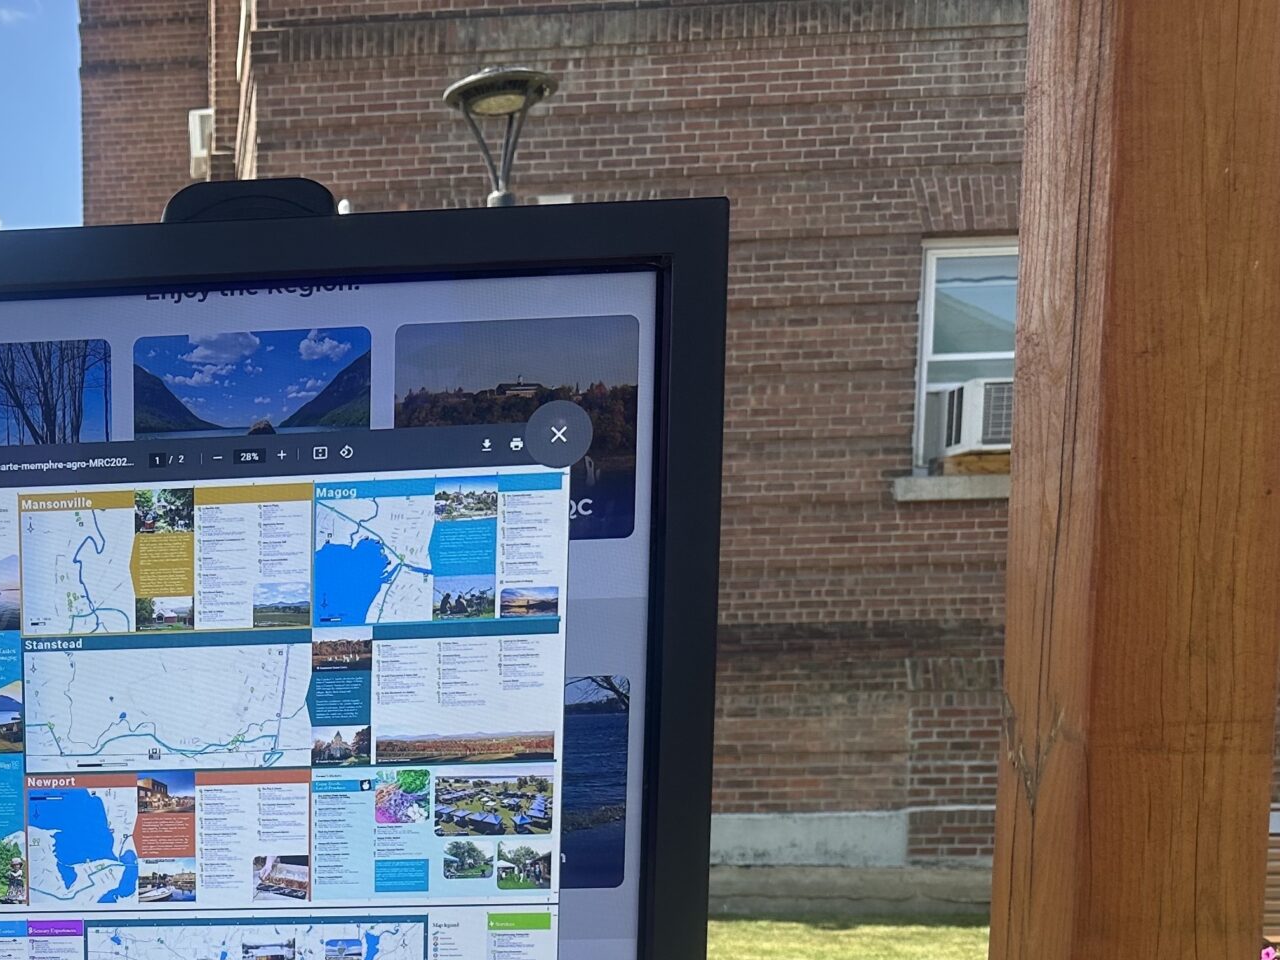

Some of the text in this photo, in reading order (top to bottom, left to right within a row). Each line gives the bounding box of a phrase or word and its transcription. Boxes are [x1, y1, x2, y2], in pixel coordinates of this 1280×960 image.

[178, 455, 185, 464] 2
[240, 452, 259, 461] 28%
[316, 487, 357, 499] Magog
[21, 498, 93, 510] Mansonville
[25, 638, 83, 650] Stanstead
[27, 777, 76, 789] Newport
